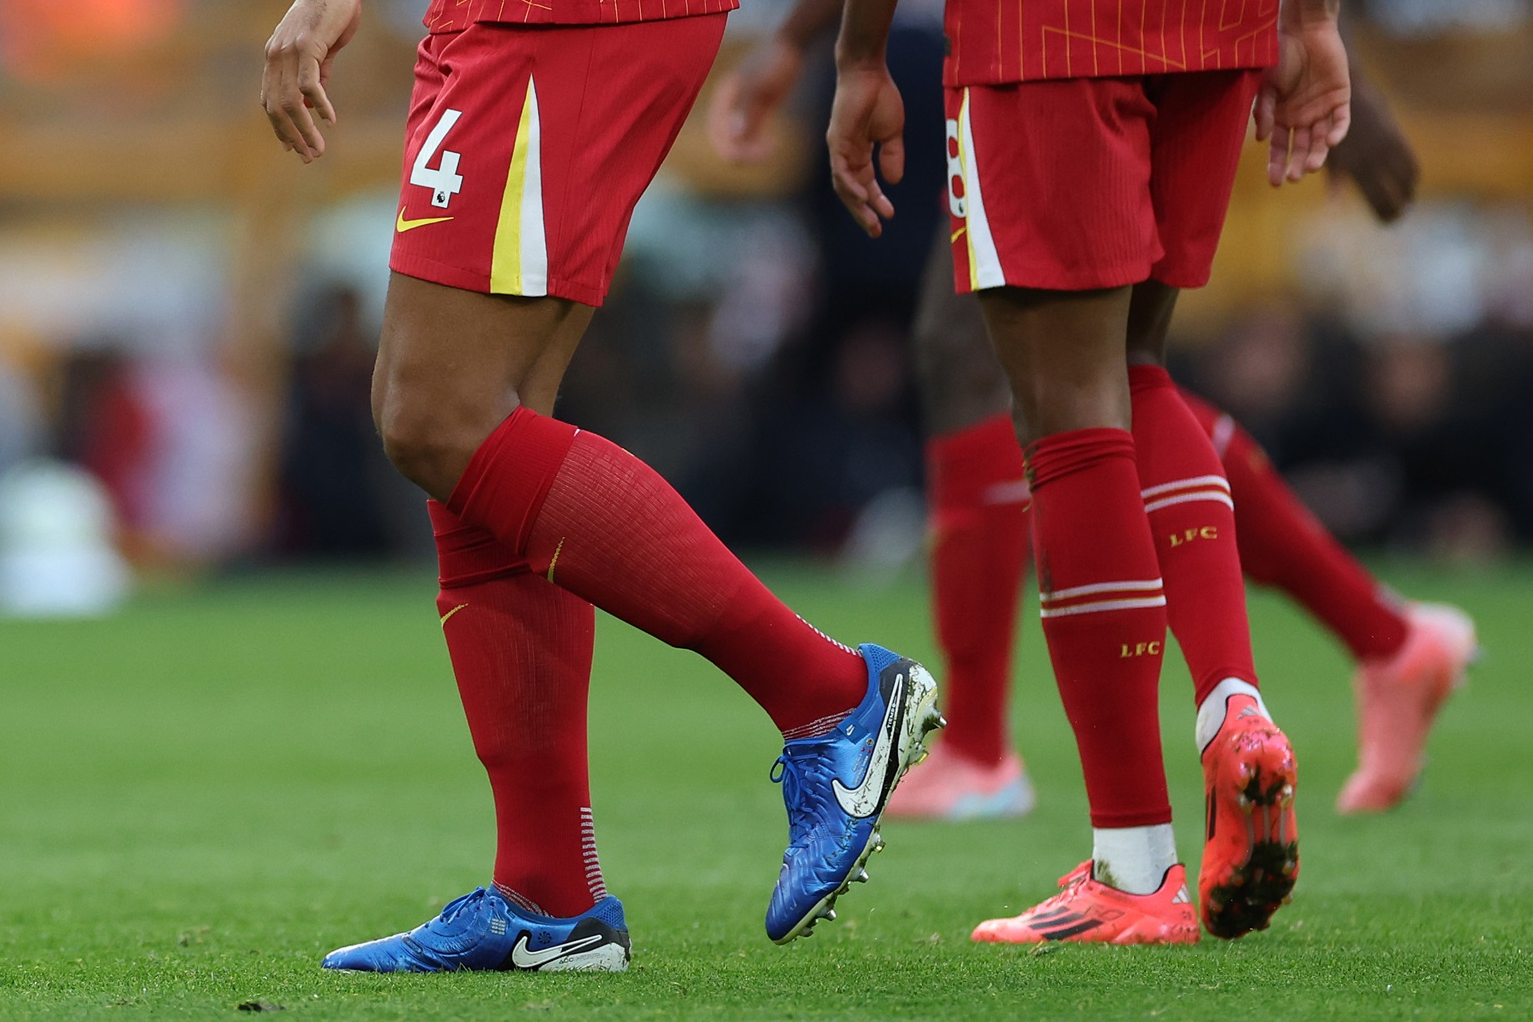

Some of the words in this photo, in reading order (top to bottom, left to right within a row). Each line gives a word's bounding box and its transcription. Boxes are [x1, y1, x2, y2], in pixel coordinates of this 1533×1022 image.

[410, 108, 463, 208] 4
[1169, 526, 1218, 548] LFC
[1120, 641, 1161, 658] LFC
